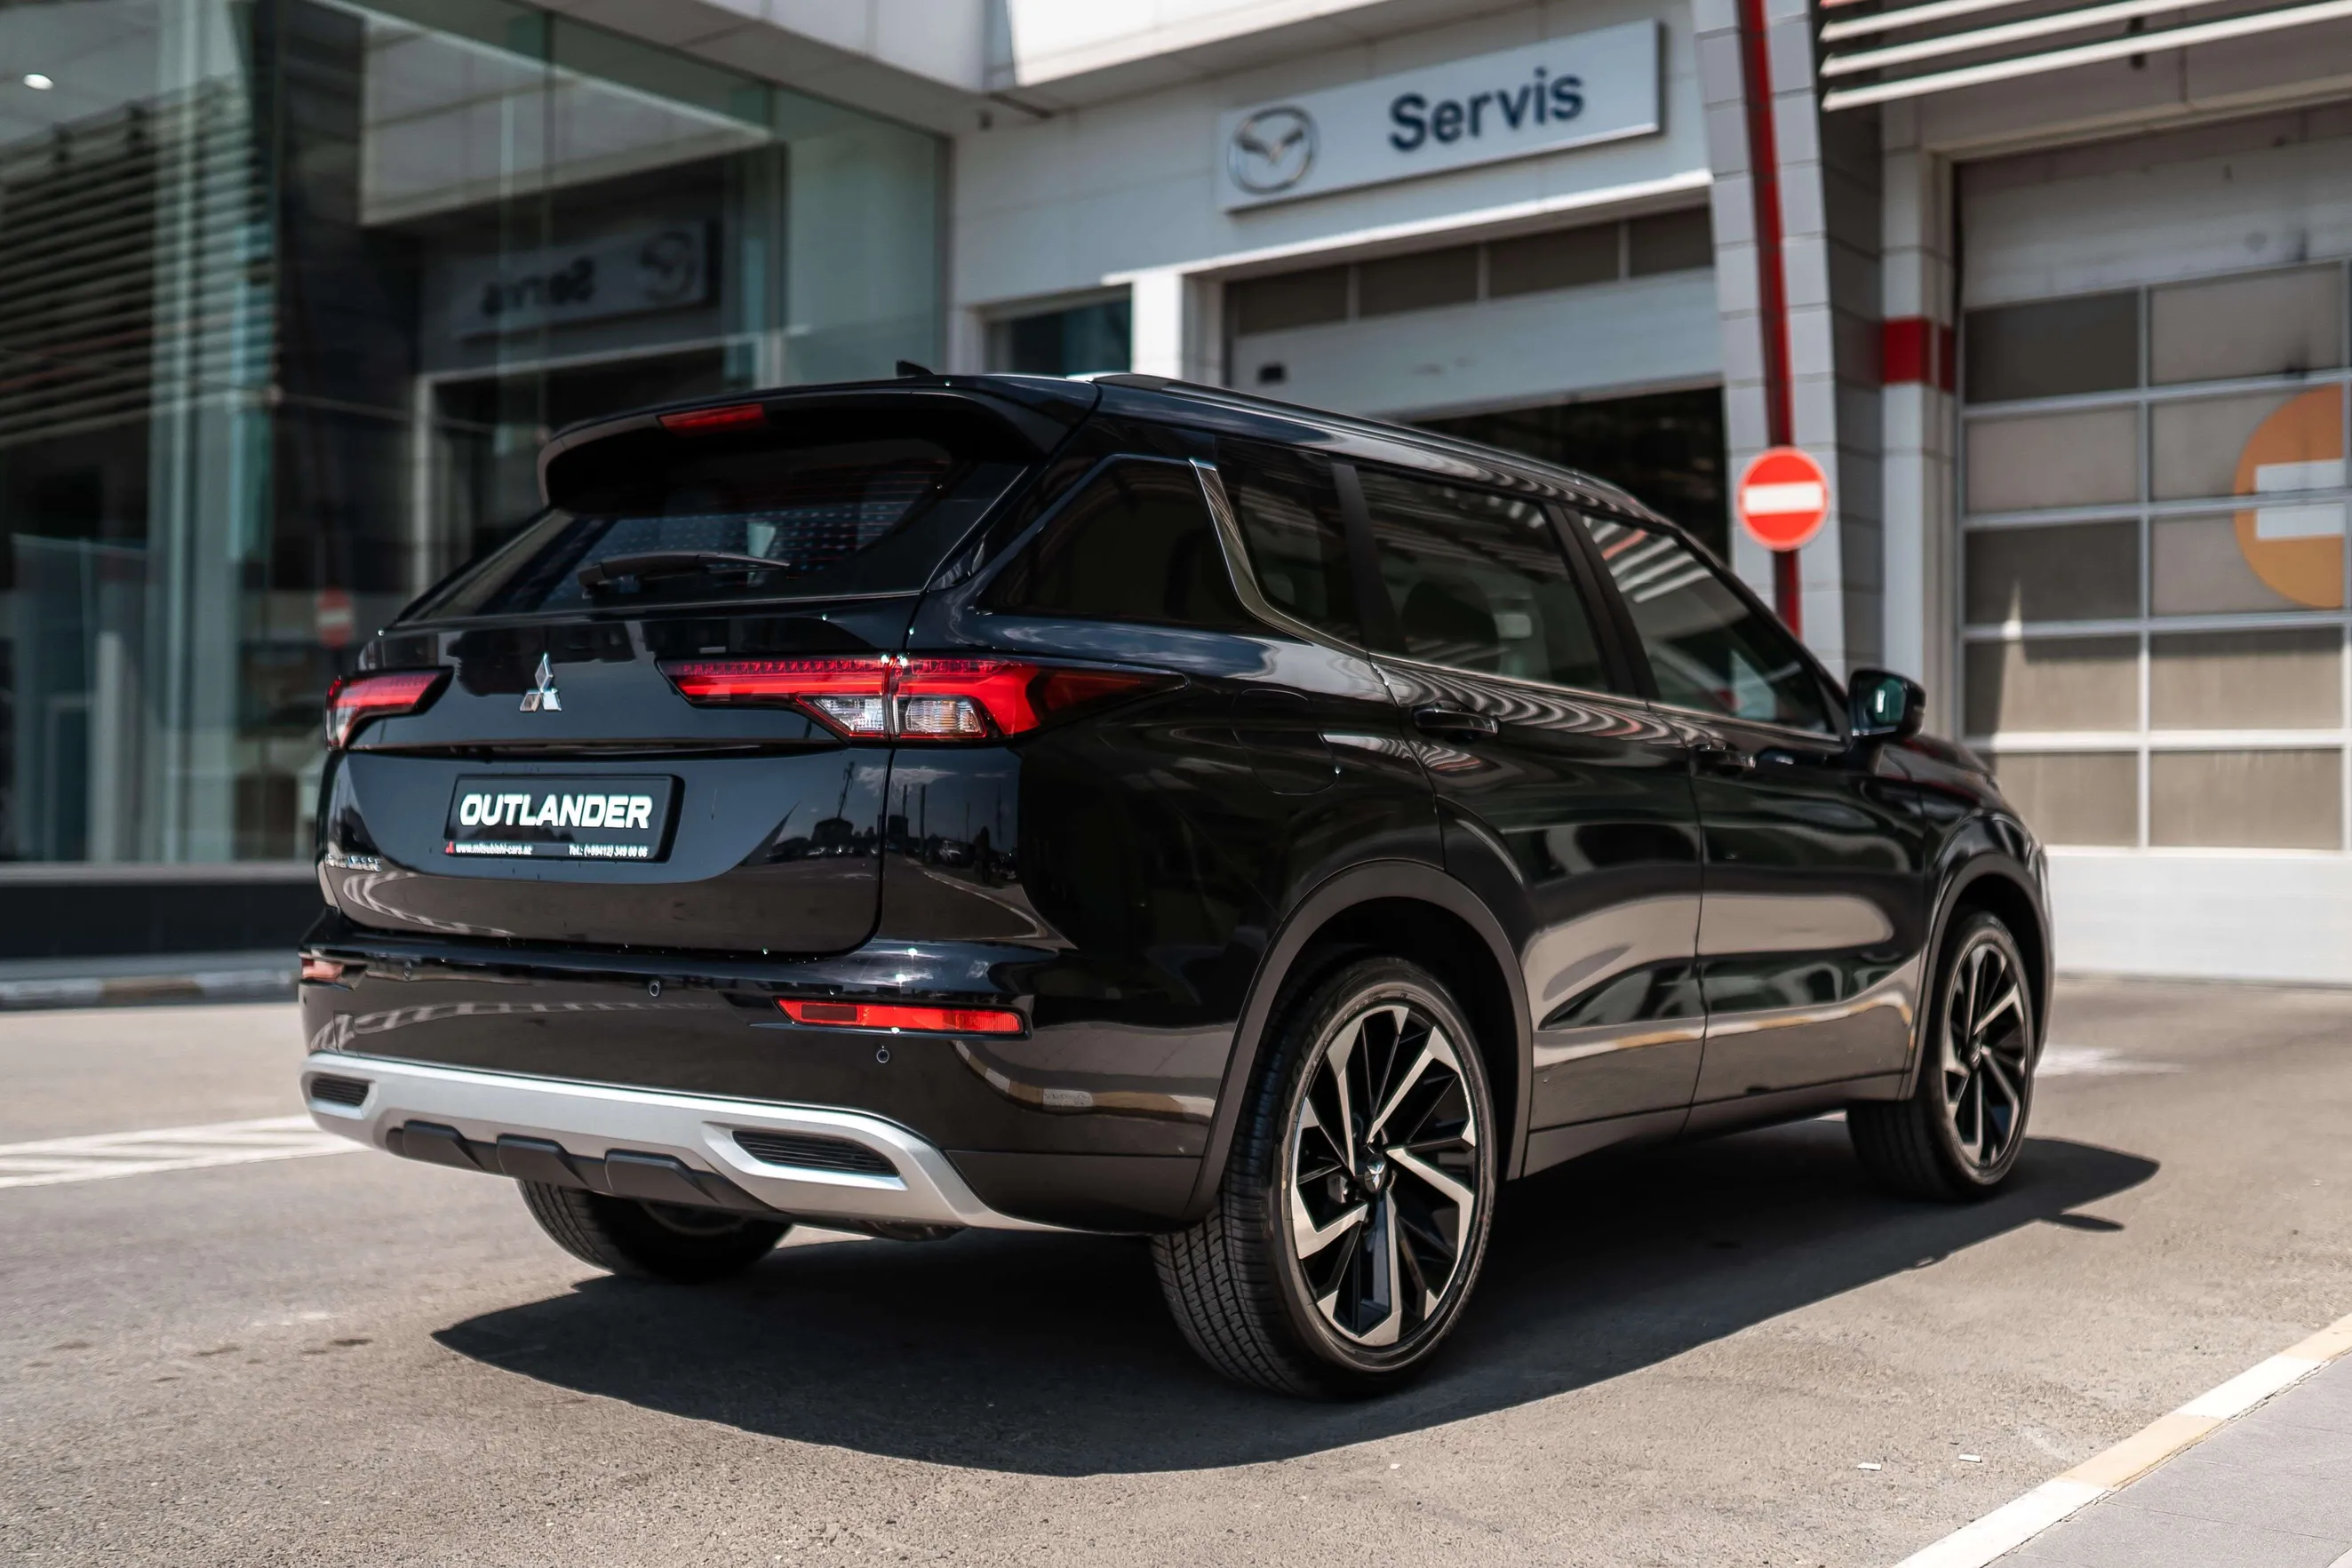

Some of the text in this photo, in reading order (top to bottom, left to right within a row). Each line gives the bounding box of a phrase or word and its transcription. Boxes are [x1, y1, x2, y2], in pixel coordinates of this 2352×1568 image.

[1389, 66, 1585, 153] Servis
[459, 792, 653, 829] OUTLANDER
[455, 843, 533, 856] www.mitsubishi-cars.az
